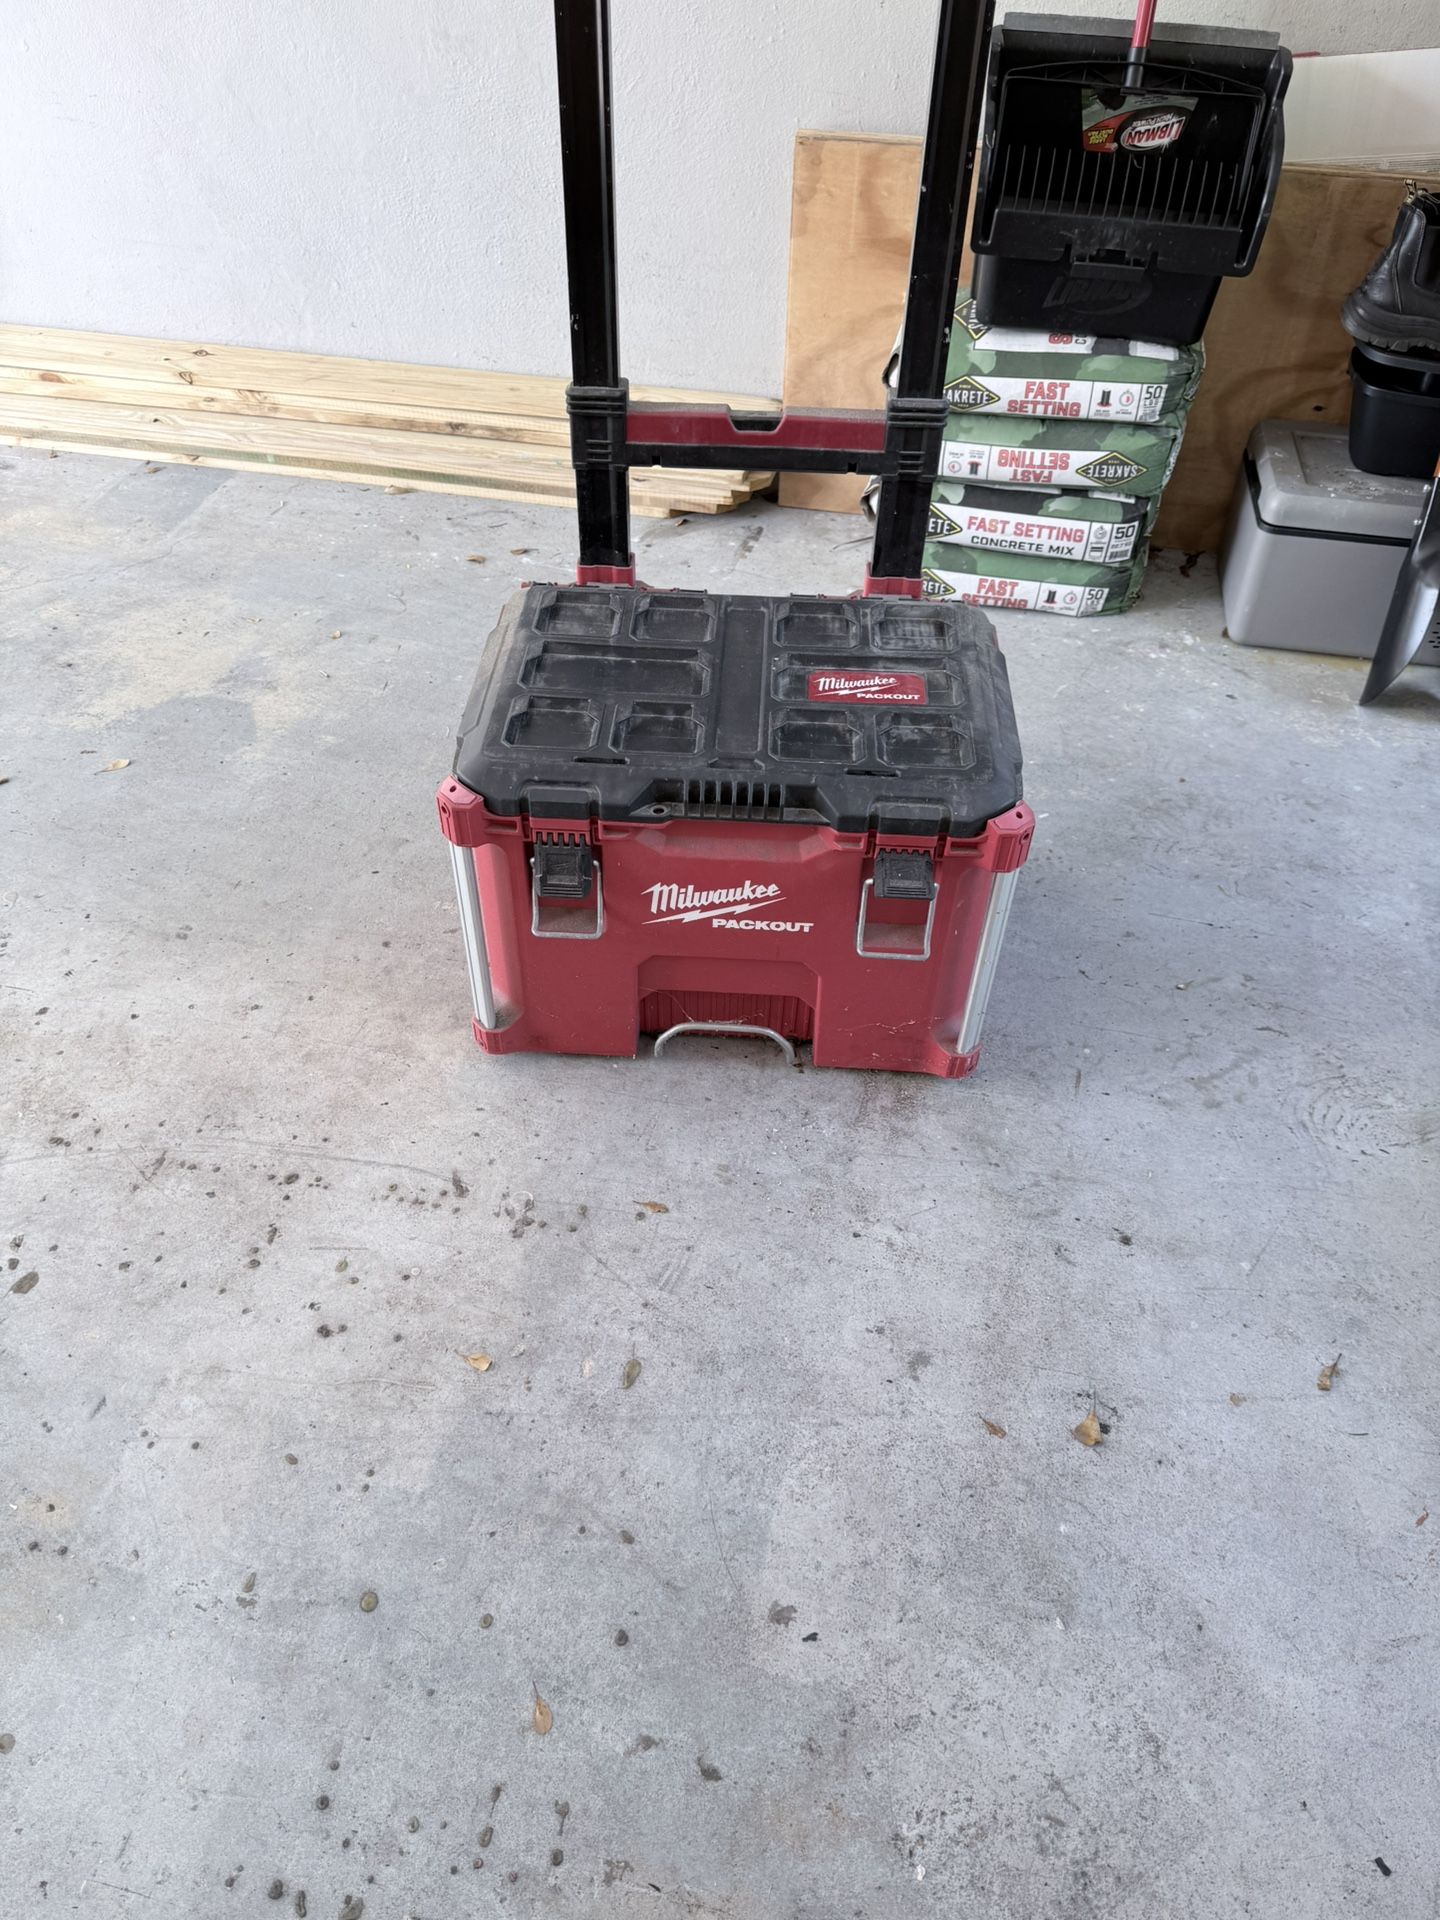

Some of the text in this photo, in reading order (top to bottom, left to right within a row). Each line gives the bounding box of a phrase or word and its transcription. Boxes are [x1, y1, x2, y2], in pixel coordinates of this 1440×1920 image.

[1125, 116, 1185, 145] LIBMAN
[943, 389, 990, 404] AKRETE
[1024, 381, 1071, 401] FAST
[1144, 385, 1163, 400] 50
[1007, 399, 1082, 417] SETTING
[997, 449, 1071, 471] SETTING
[1009, 469, 1053, 484] FAST
[1085, 463, 1138, 478] SAKRETE
[966, 516, 1010, 534] FAST
[1013, 522, 1085, 543] SETTING
[1114, 525, 1136, 540] 50
[971, 535, 1075, 556] CONCRETE MIX
[922, 581, 946, 595] RETE
[976, 578, 1019, 597] FAST
[1086, 588, 1105, 600] 50
[813, 676, 897, 691] Milwaukee
[641, 880, 781, 914] Milwaukee
[712, 918, 815, 933] PACKOUT
